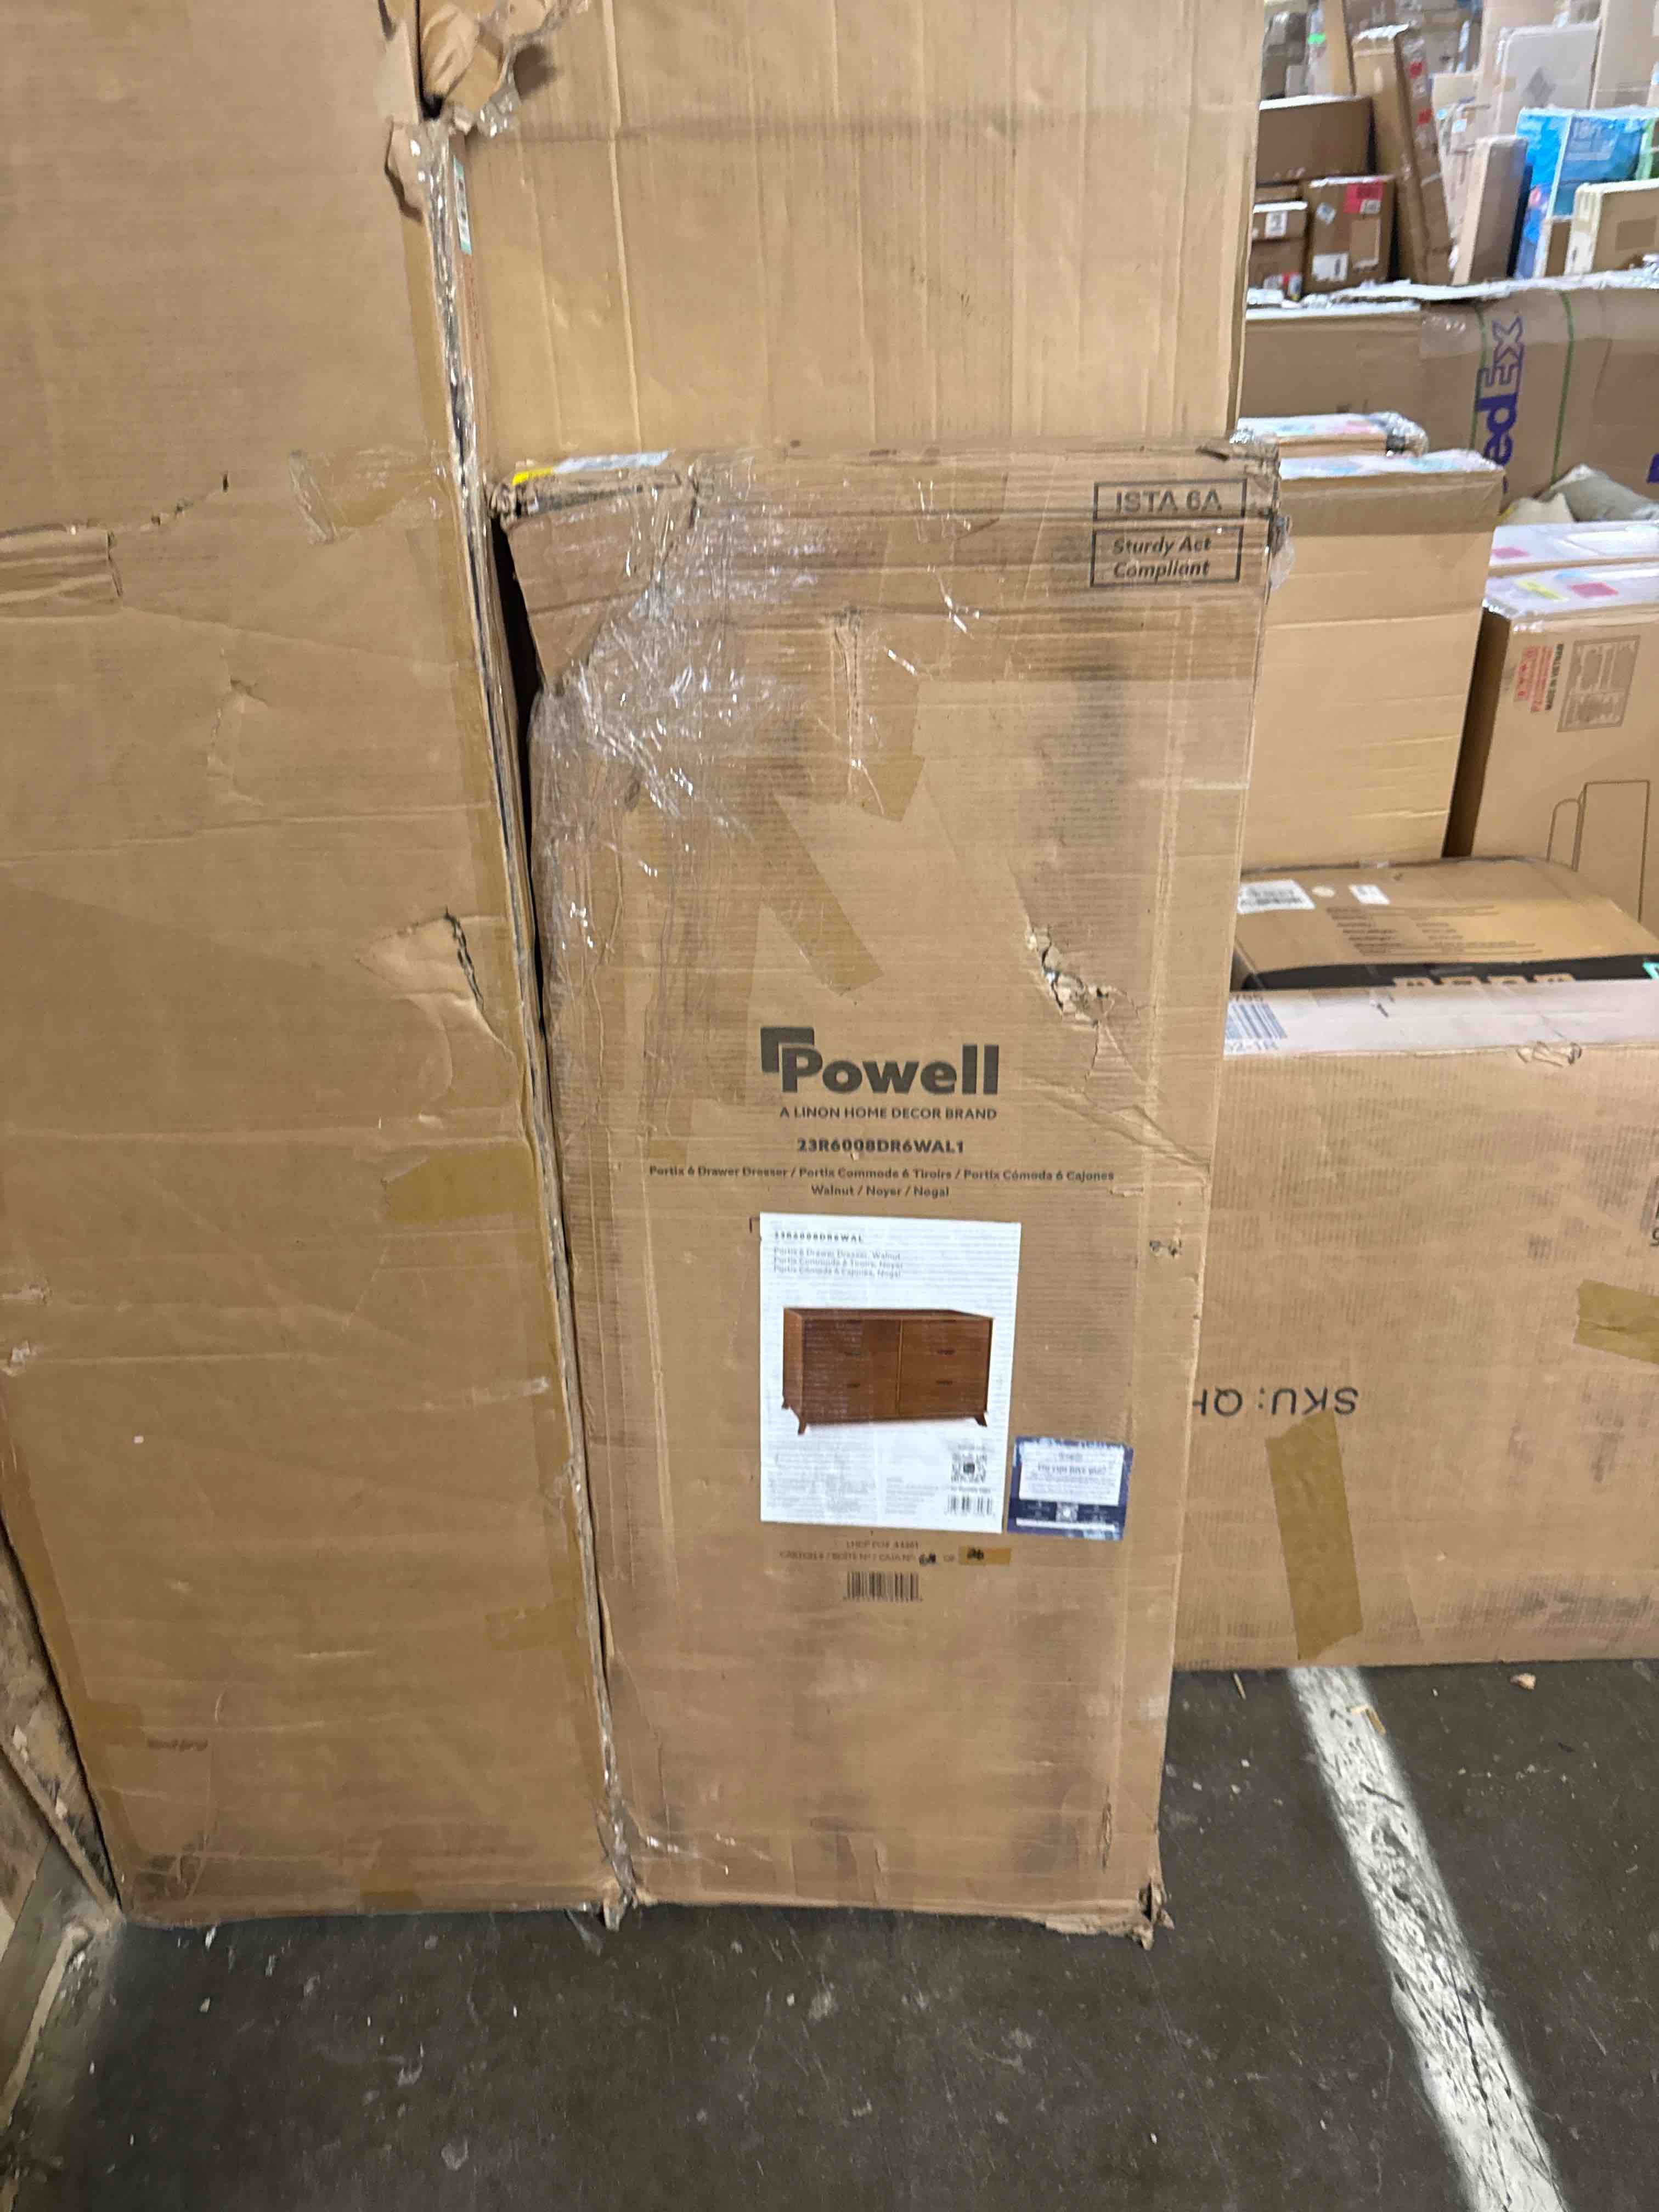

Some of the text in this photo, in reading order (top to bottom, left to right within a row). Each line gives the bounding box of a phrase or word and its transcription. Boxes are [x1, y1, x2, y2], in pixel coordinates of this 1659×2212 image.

[1116, 489, 1222, 512] ISTA 6A
[1114, 535, 1212, 556] Sturdy Act
[1114, 560, 1211, 584] Compliant
[781, 1044, 999, 1095] Powell
[780, 1107, 997, 1120] A LINON HOME DECOR BRAND
[698, 1165, 740, 1177] Drawer
[743, 1166, 788, 1177] Dresser
[790, 1166, 795, 1178] /
[912, 1167, 952, 1180] Tiroirs
[955, 1168, 960, 1180] /
[1066, 1170, 1114, 1183] Cajones
[811, 1184, 949, 1199] Walnut / Noyer / Nogal
[1259, 1386, 1359, 1415] SKU:
